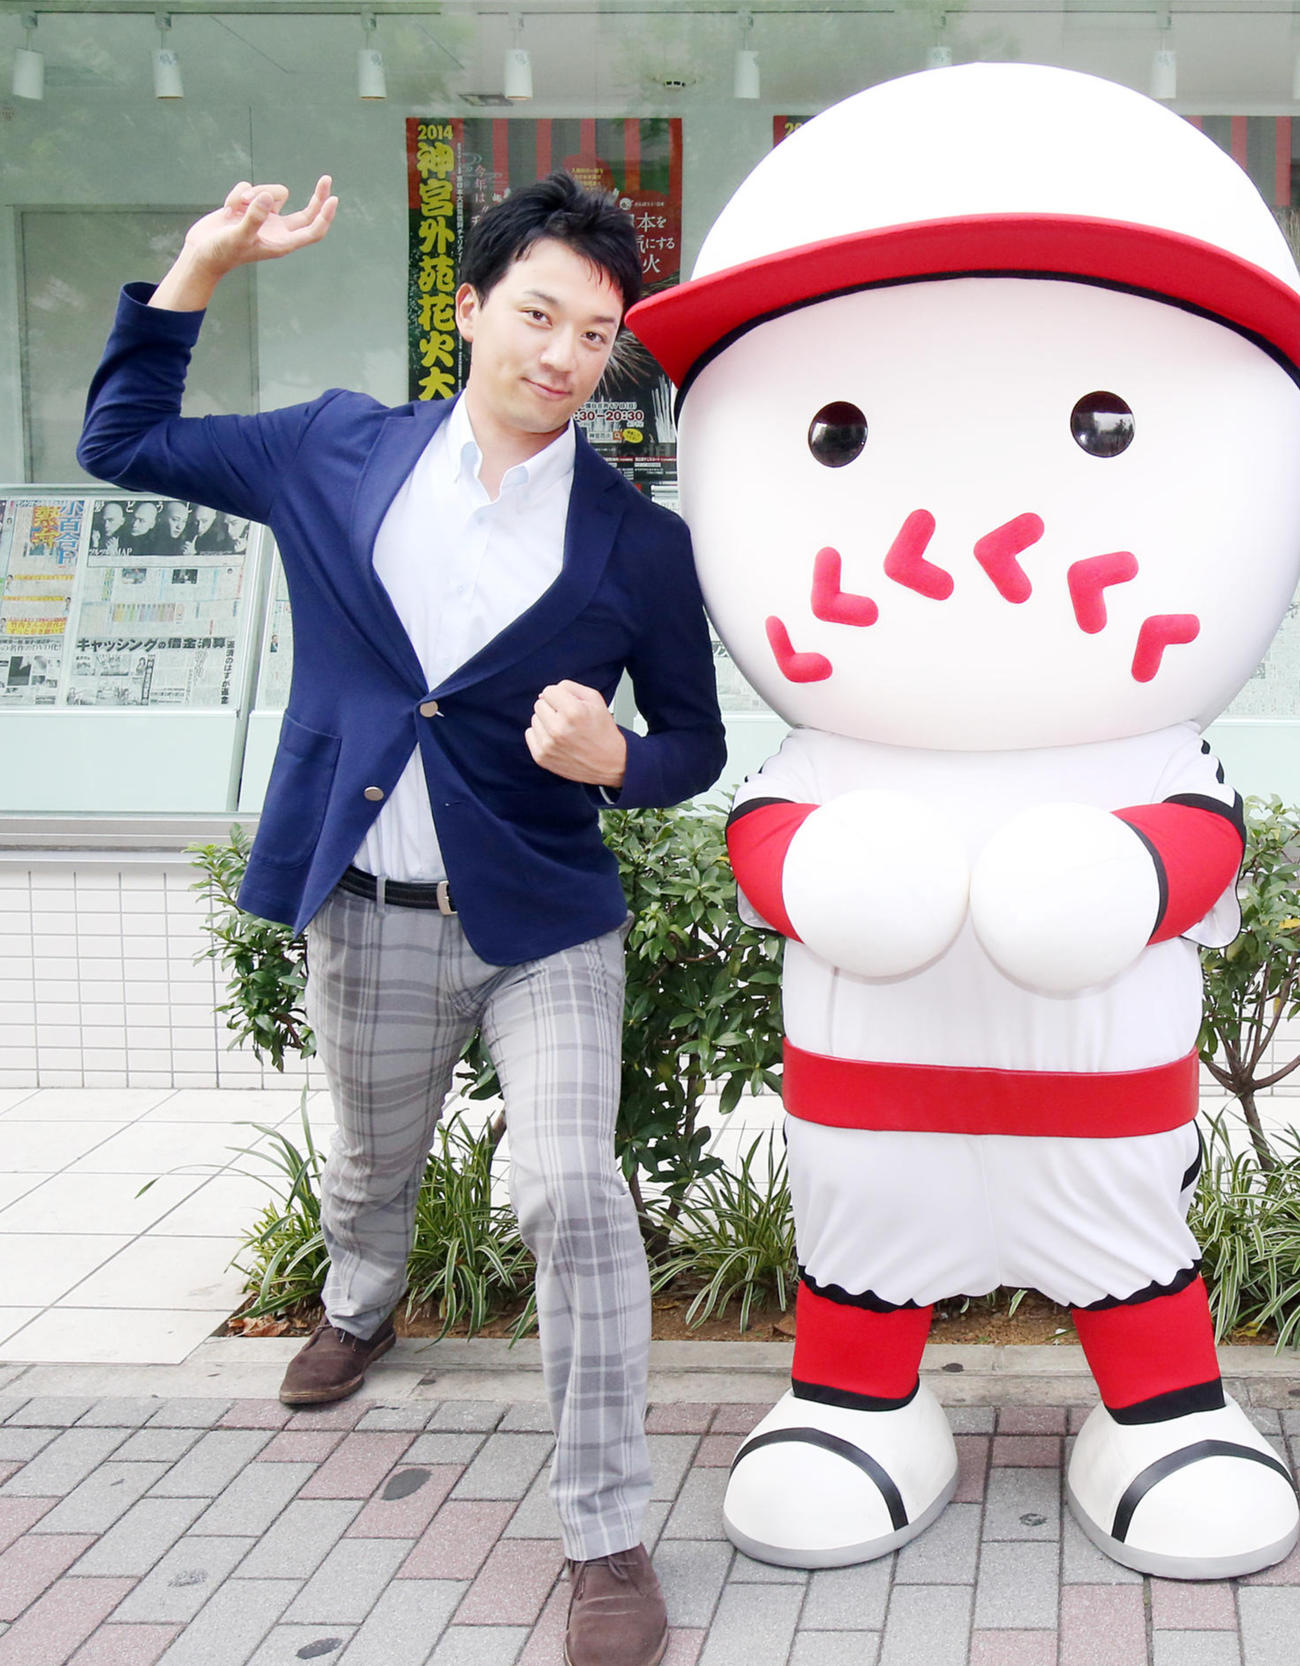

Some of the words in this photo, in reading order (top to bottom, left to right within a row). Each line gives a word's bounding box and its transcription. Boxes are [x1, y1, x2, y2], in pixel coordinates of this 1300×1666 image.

[417, 125, 454, 140] 2014
[630, 212, 667, 232] 本を
[416, 141, 456, 401] 神宮外苑花火大
[642, 254, 661, 273] 火
